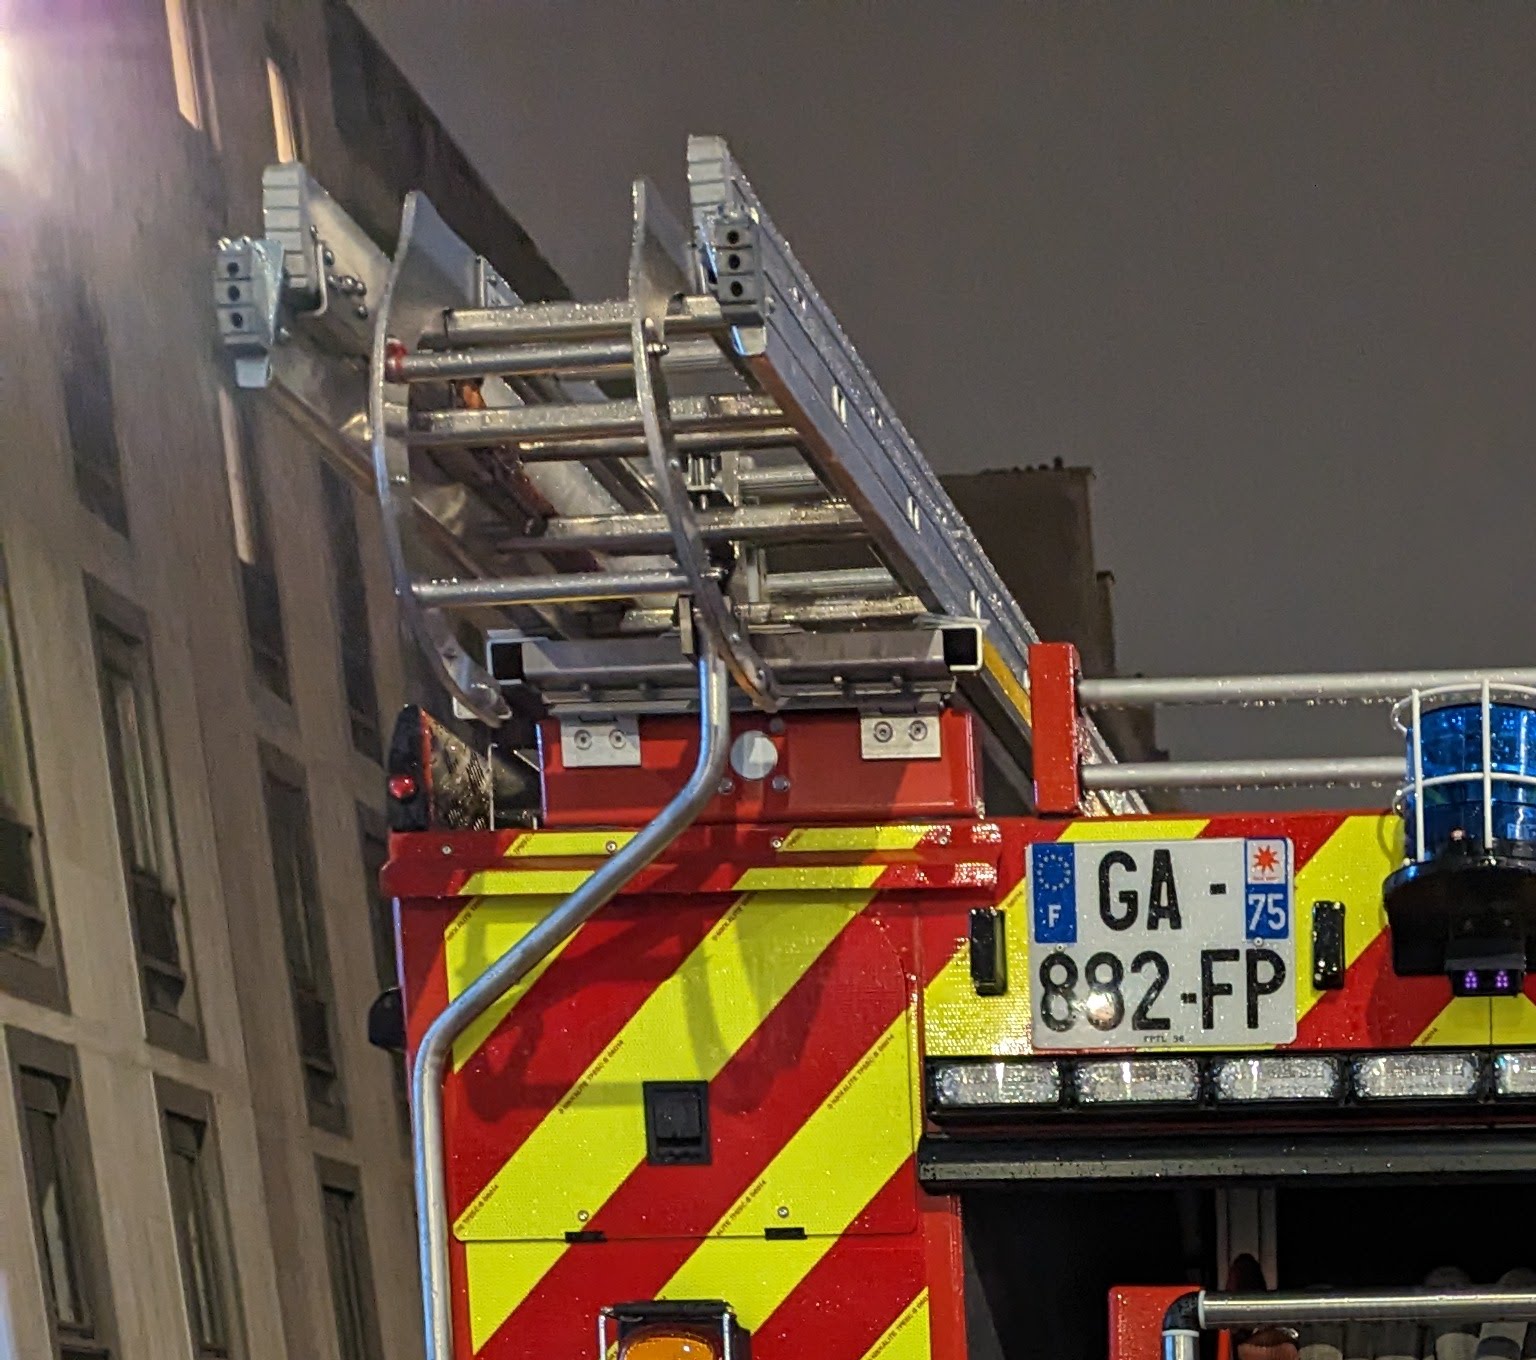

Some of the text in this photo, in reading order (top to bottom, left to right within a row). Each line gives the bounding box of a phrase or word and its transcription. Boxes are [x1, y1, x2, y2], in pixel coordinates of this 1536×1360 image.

[1047, 904, 1062, 928] F
[1248, 893, 1286, 931] 75
[1039, 948, 1287, 1032] 882-FP
